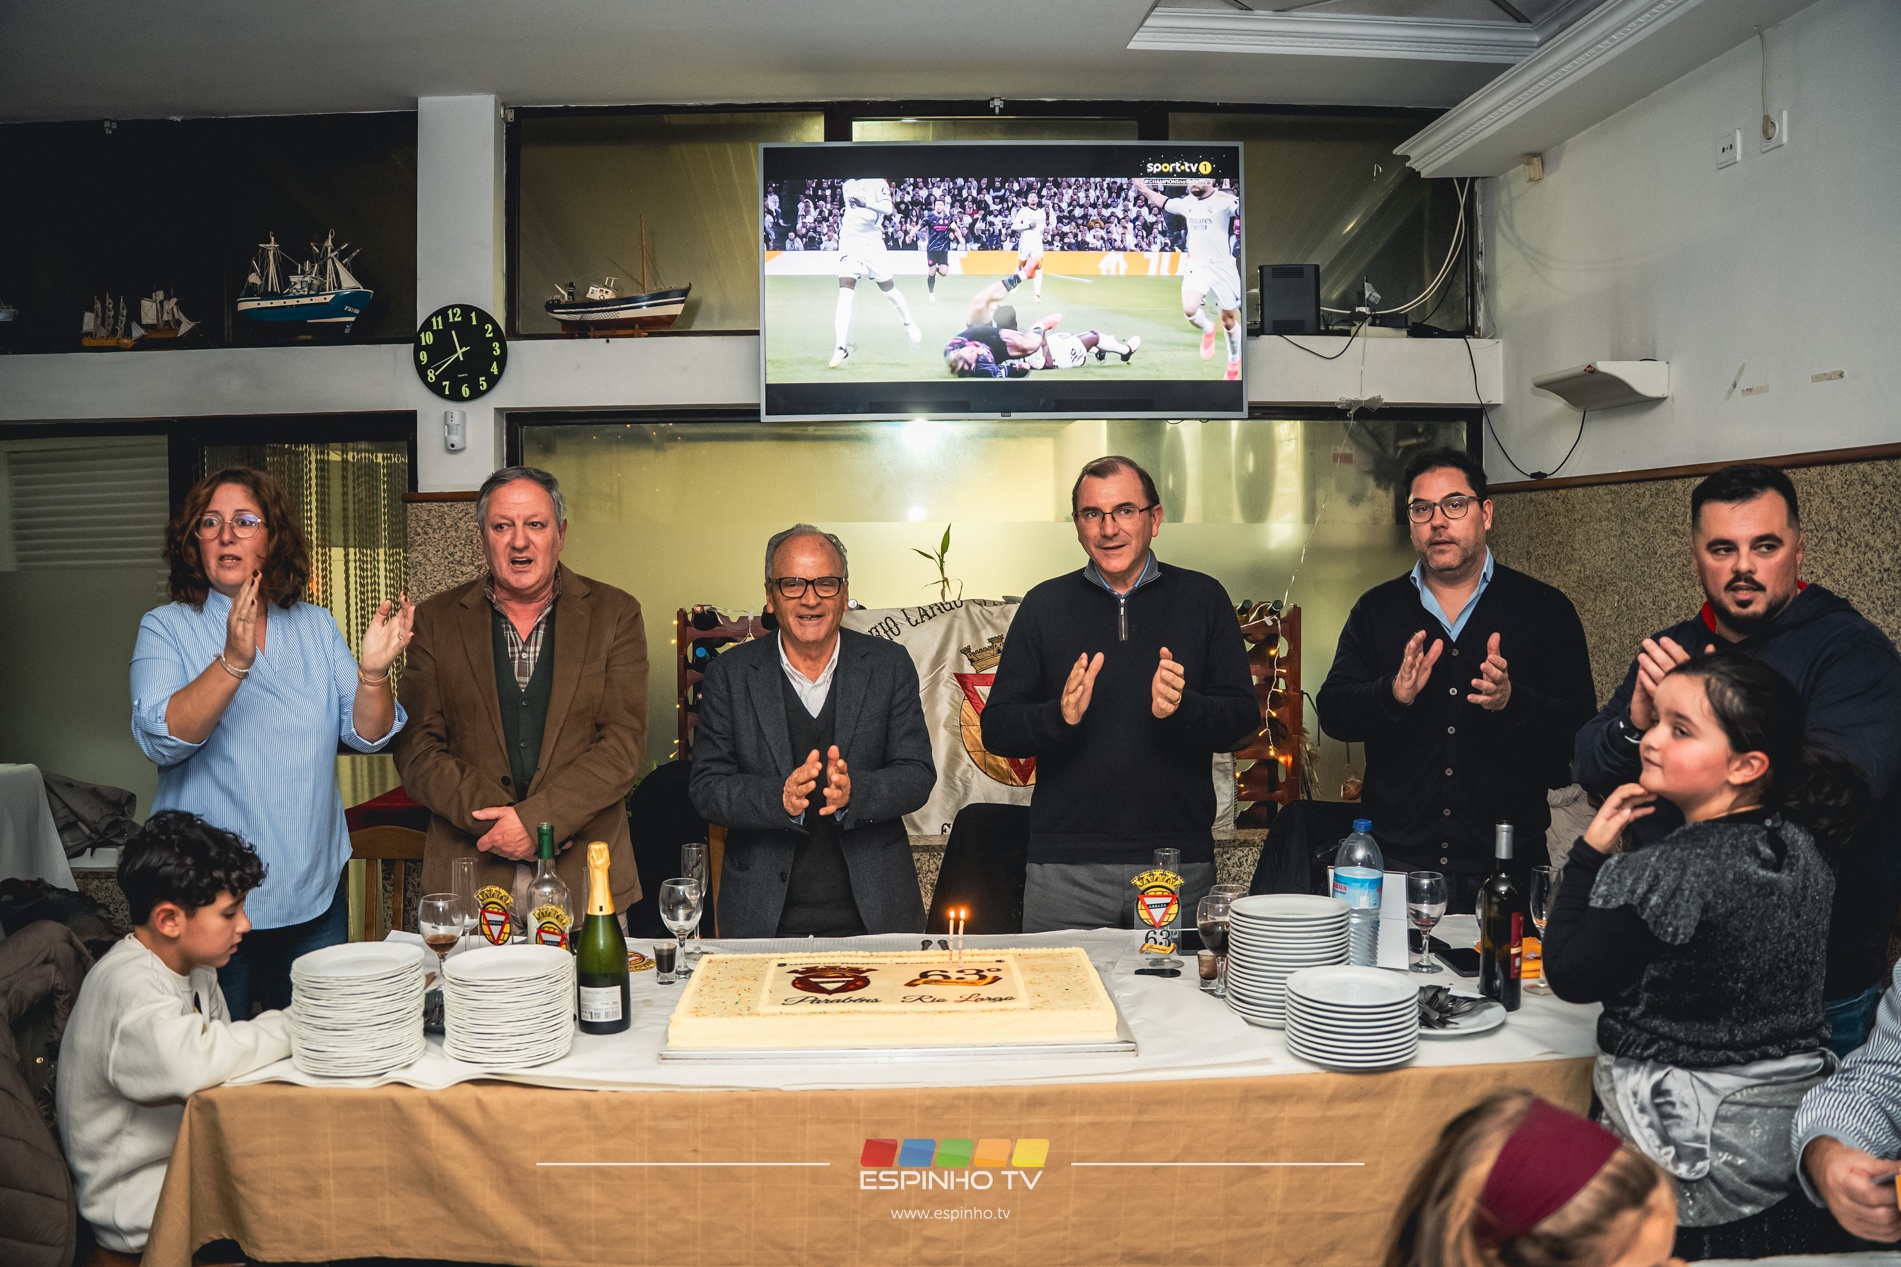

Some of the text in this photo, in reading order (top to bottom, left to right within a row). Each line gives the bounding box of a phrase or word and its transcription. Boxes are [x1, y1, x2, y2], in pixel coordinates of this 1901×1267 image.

[447, 307, 462, 322] 12
[470, 311, 477, 325] 1
[431, 315, 443, 330] 11
[484, 323, 493, 337] 2
[420, 331, 434, 345] 10
[492, 341, 501, 356] 3
[419, 350, 428, 365] 9
[427, 368, 436, 383] 8
[490, 361, 498, 375] 4
[442, 380, 450, 395] 7
[461, 383, 470, 398] 6
[479, 376, 487, 390] 5
[900, 993, 1017, 1003] Rio Largo
